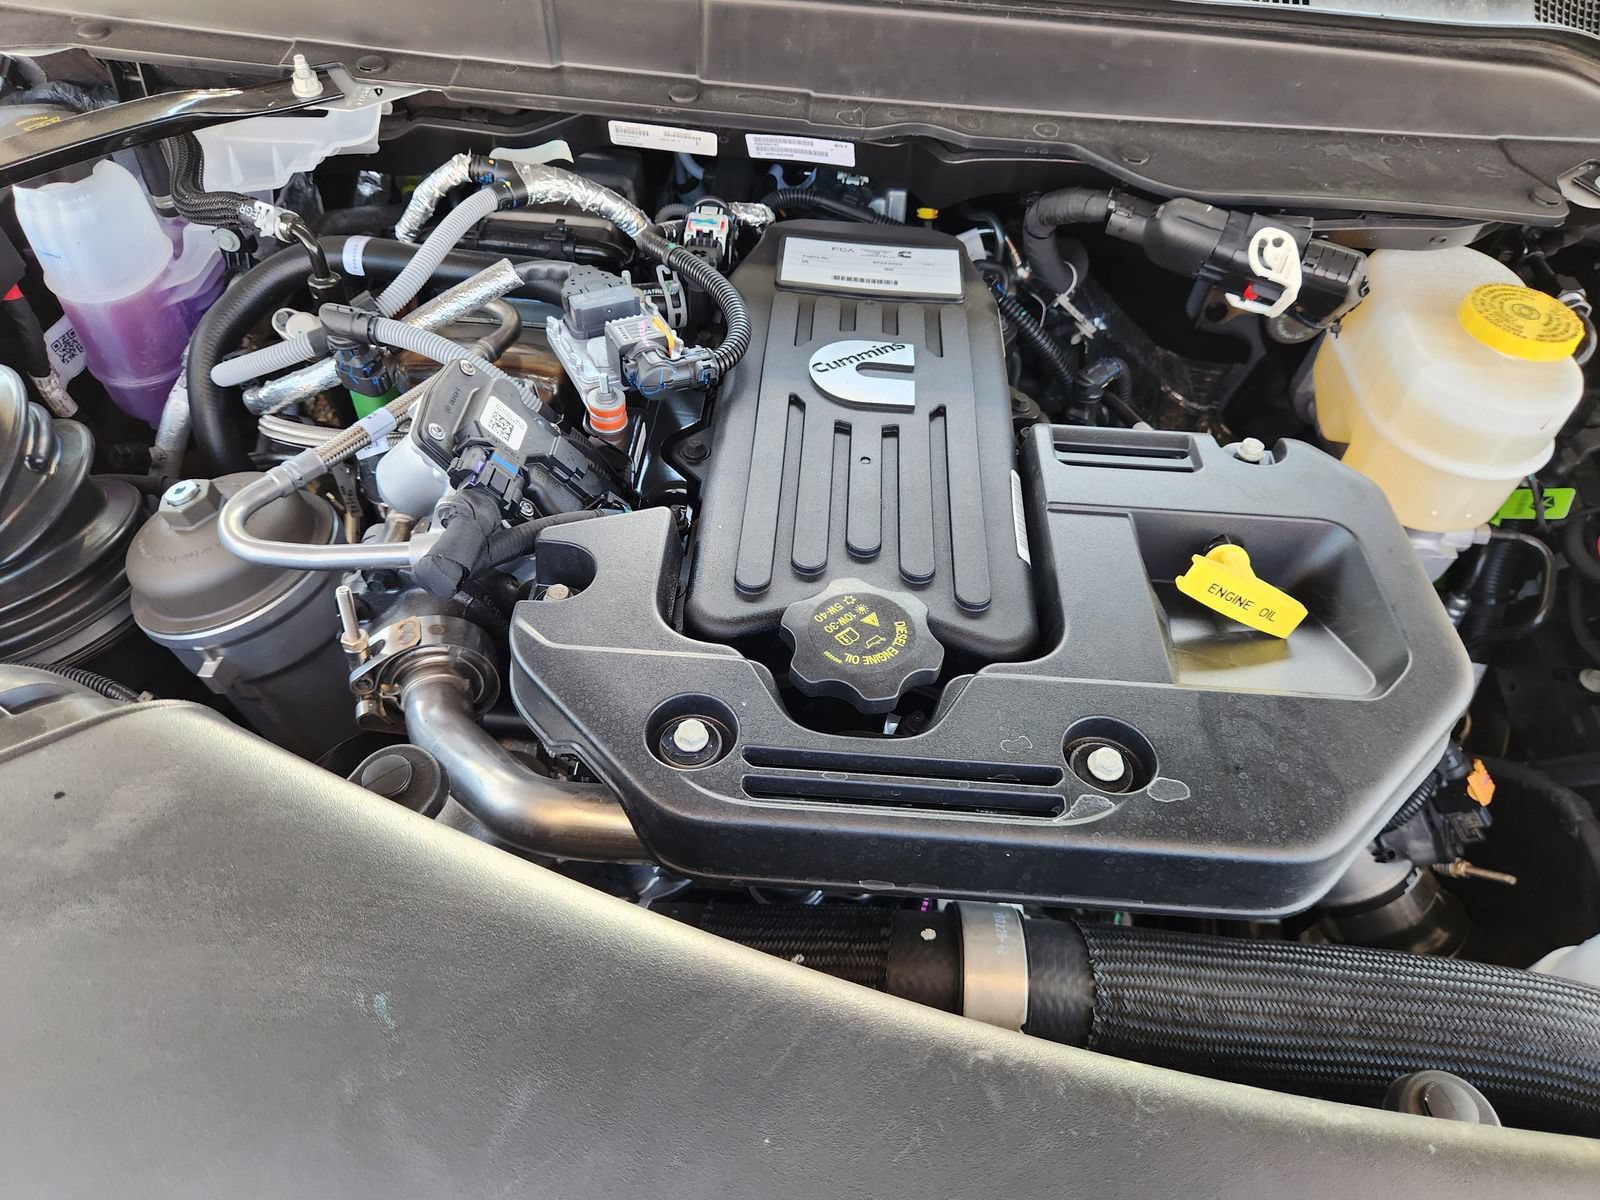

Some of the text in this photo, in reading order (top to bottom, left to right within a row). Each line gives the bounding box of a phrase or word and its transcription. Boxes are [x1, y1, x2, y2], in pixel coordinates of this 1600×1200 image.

[240, 203, 259, 220] EGR
[811, 343, 906, 373] Cummins
[814, 602, 844, 623] 5W-40
[1207, 582, 1277, 623] ENGINE OIL
[823, 611, 857, 634] 10W-30
[892, 620, 908, 648] DIESEL
[844, 652, 860, 665] OIL
[862, 646, 900, 665] ENGINE
